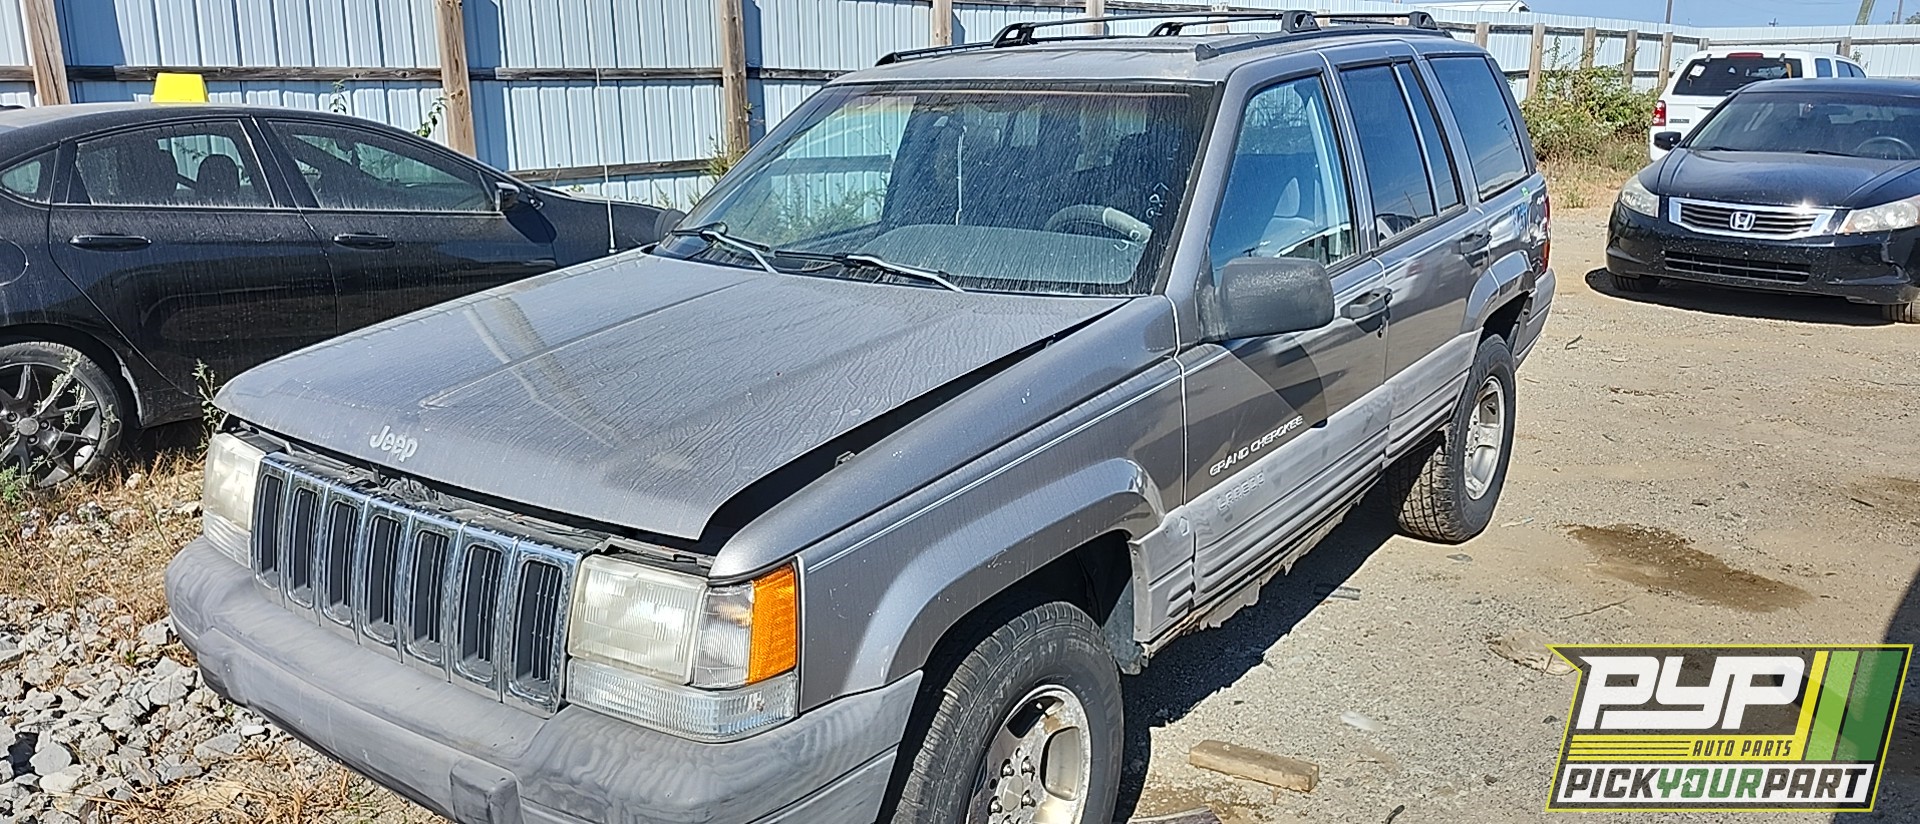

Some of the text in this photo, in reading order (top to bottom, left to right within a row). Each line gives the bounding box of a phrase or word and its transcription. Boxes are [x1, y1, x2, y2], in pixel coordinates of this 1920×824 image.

[369, 425, 418, 463] Jeep
[1209, 414, 1304, 477] GRAND CHEROKEE
